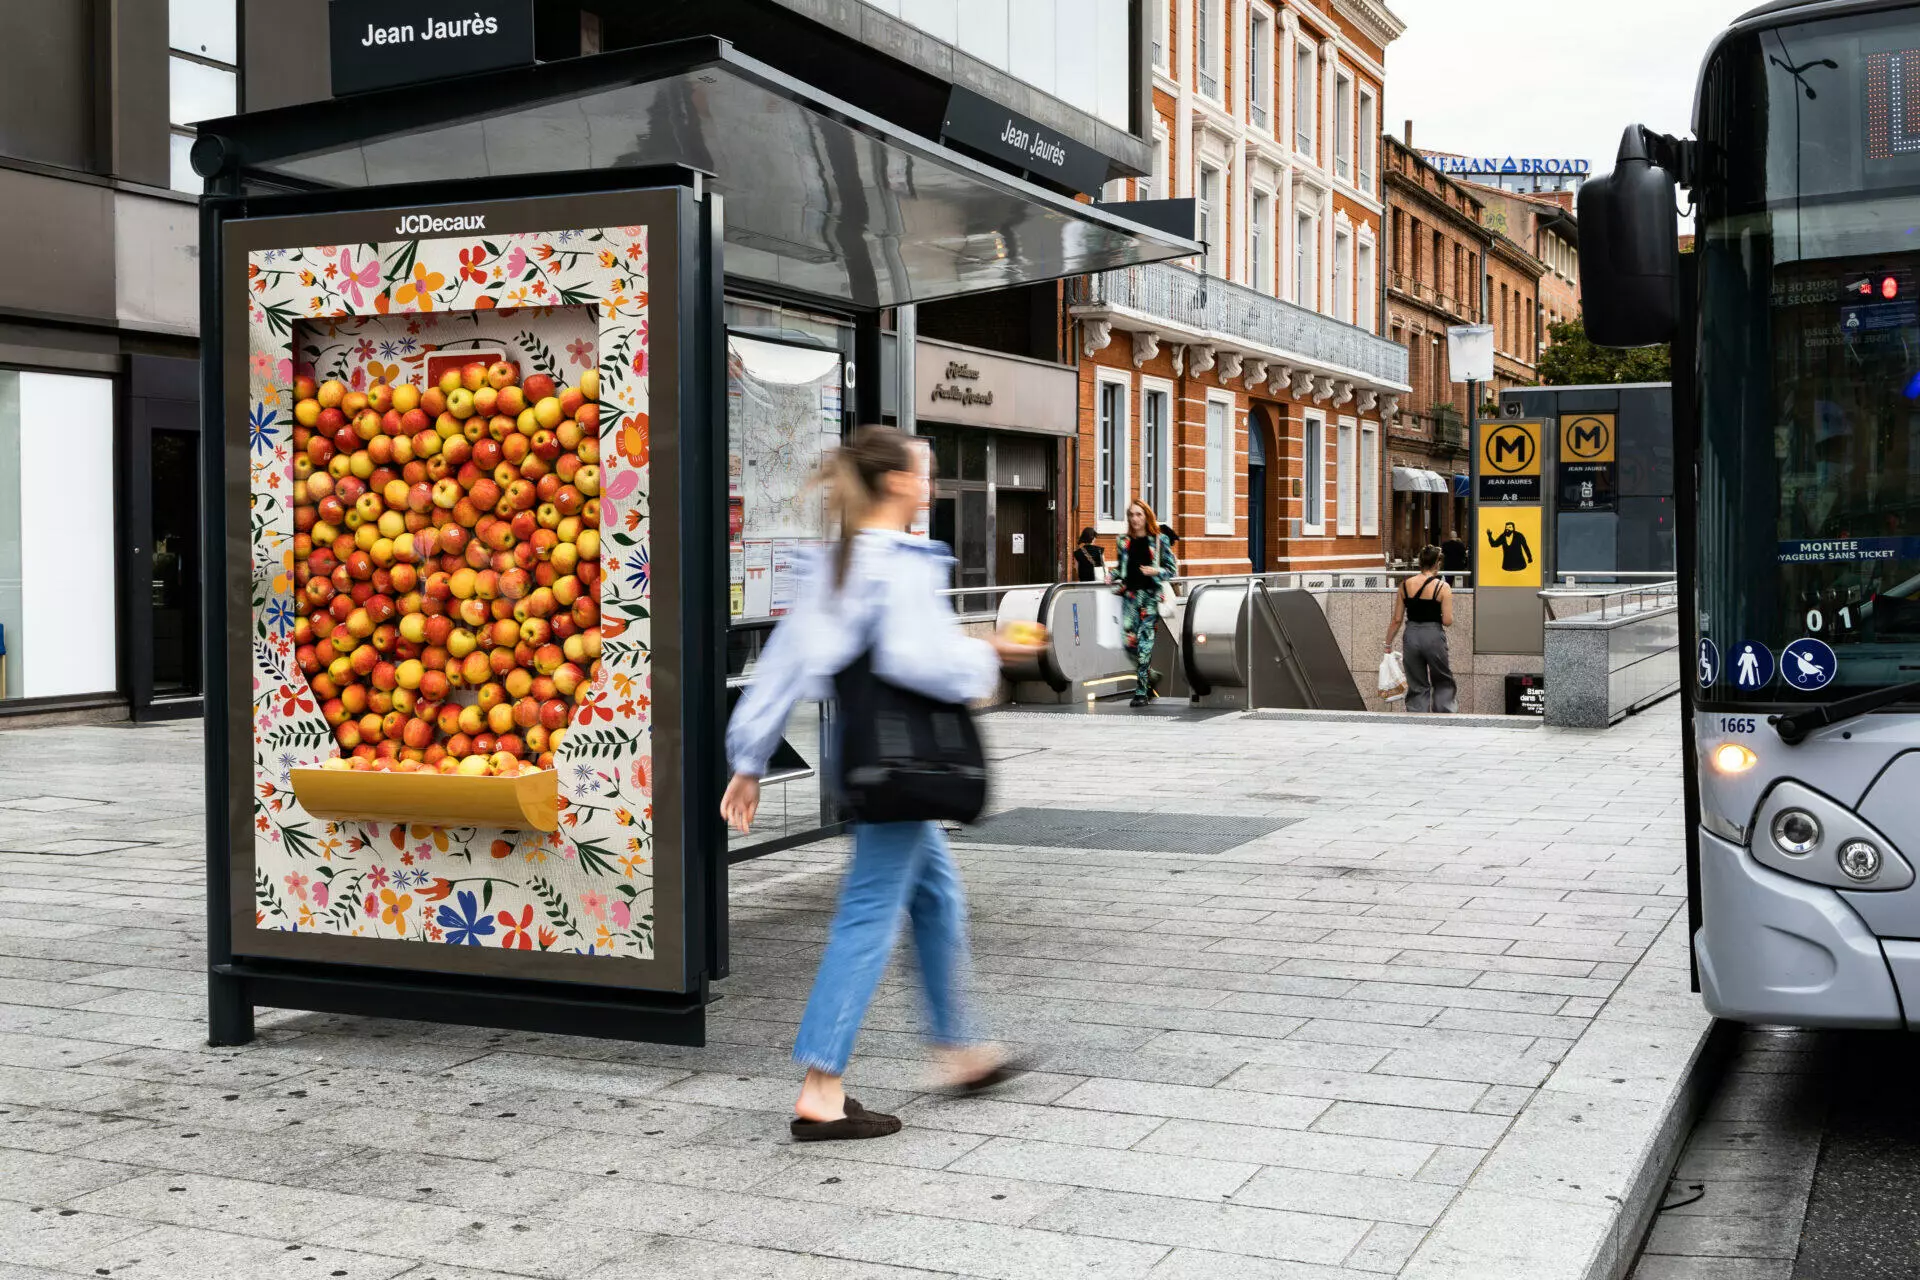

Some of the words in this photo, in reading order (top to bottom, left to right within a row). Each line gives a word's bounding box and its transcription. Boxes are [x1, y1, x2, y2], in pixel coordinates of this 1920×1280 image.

[361, 23, 415, 47] Jean
[420, 12, 498, 41] Jaurès
[1001, 119, 1029, 150] Jean
[1029, 132, 1066, 167] Jaurès
[395, 214, 486, 235] JCDecaux
[1778, 553, 1825, 561] YAGEURS
[1858, 550, 1895, 558] TICKET
[1800, 541, 1858, 552] MONTEE
[1720, 717, 1756, 733] 1665
